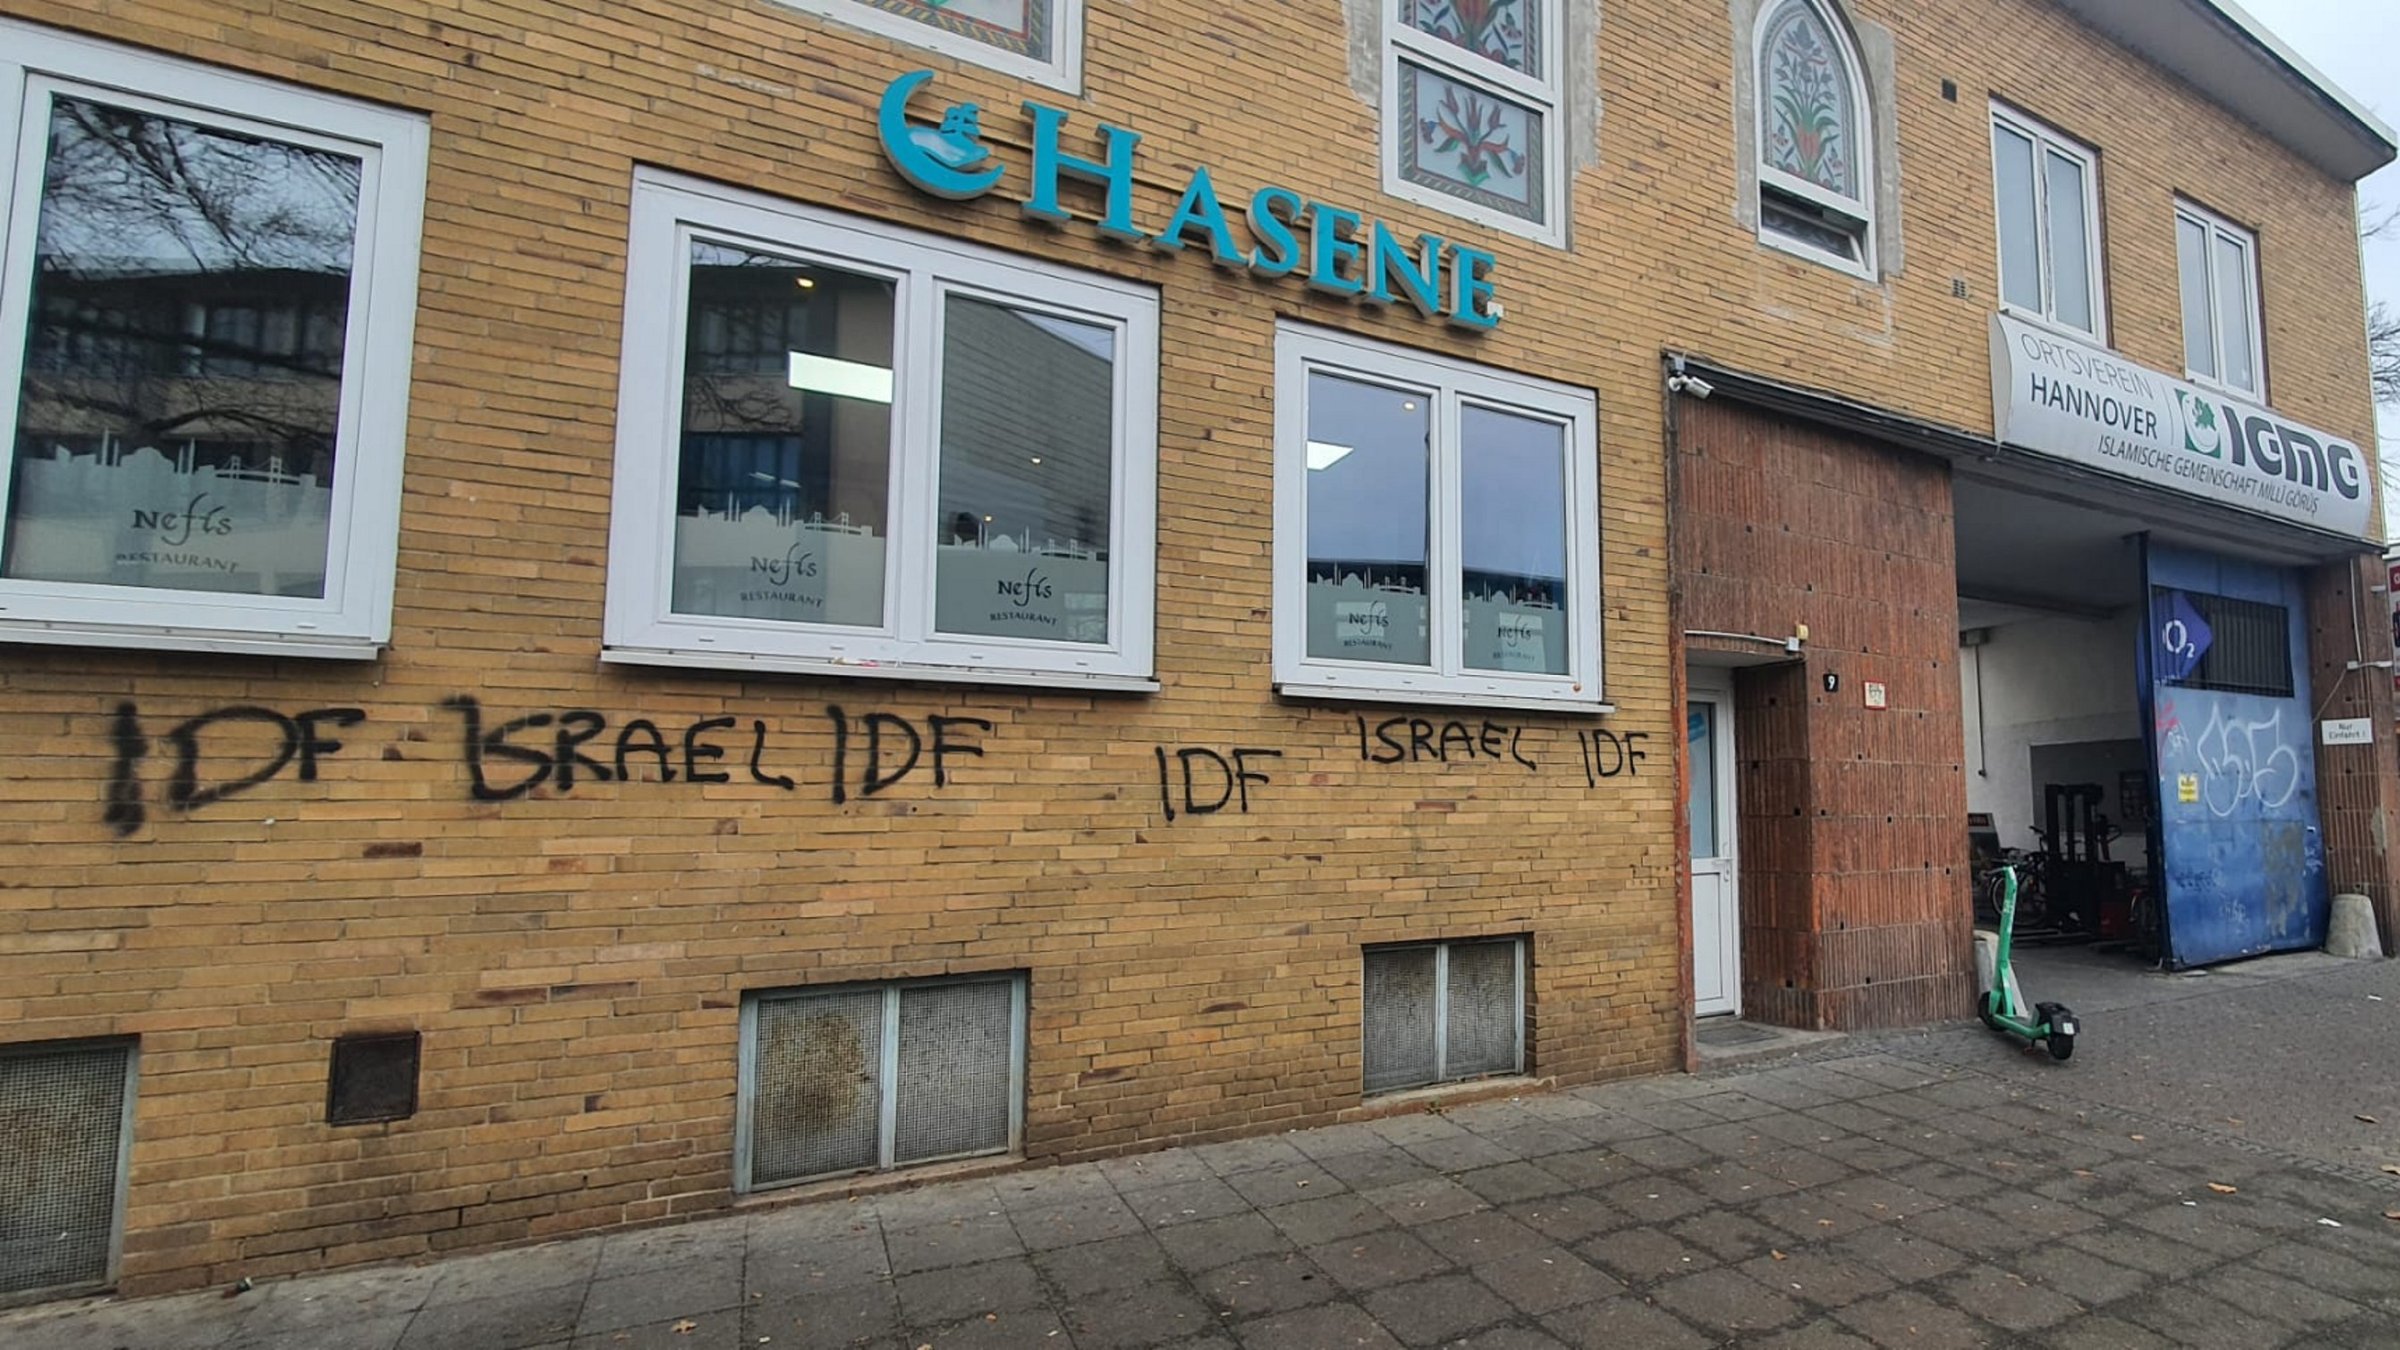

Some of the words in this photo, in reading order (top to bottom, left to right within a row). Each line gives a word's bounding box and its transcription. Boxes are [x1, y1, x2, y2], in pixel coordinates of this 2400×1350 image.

[2021, 333, 2153, 400] ORTSVEREIN
[2030, 372, 2158, 440] HANNOVER
[2098, 434, 2172, 474] ISLAMISCHE
[2174, 456, 2258, 497] GEMEINSCHAFT
[115, 552, 239, 574] RESTAURANT
[740, 591, 823, 608] RESTAURANT
[990, 611, 1057, 626] RESTAURANT
[105, 701, 367, 837] IDF
[440, 694, 796, 803] ISRAEL
[826, 704, 991, 804] IDF
[1357, 715, 1537, 772] ISRAEL
[1578, 729, 1649, 789] IDF
[1155, 745, 1283, 822] IDF
